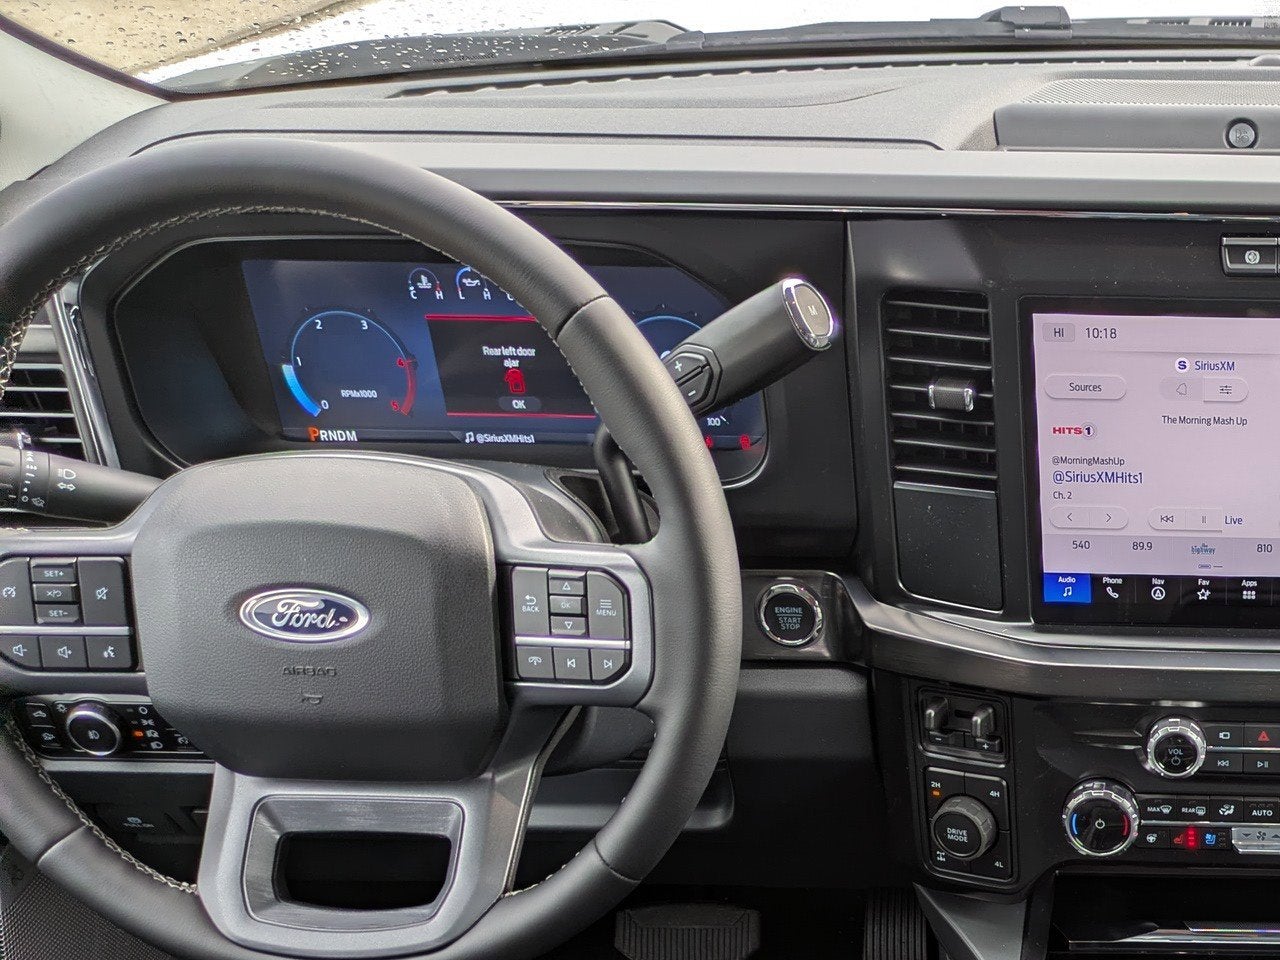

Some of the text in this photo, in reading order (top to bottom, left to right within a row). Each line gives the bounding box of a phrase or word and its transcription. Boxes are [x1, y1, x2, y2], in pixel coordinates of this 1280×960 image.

[410, 291, 417, 299] C
[435, 291, 443, 300] H
[459, 291, 465, 300] L
[483, 291, 491, 300] H
[315, 320, 323, 329] 2
[361, 320, 368, 330] 3
[1054, 328, 1064, 337] HI
[1085, 328, 1117, 339] 10:18
[482, 346, 535, 357] Rear left door
[296, 357, 302, 366] 1
[1195, 360, 1235, 371] SiriusXM
[1069, 383, 1102, 392] Sources
[321, 400, 329, 410] 0
[512, 400, 526, 409] OK
[707, 417, 721, 427] 100
[1162, 415, 1247, 427] The Morning Mash Up
[1053, 427, 1082, 435] HITS
[476, 434, 535, 444] @SiriusXMHits1
[1052, 456, 1125, 466] @MorningMashUp
[1053, 470, 1143, 484] @SiriusXMHits1
[1053, 491, 1072, 499] Ch. 2
[1224, 516, 1243, 525] Live
[1072, 540, 1091, 550] 540
[1132, 541, 1152, 551] 89.9
[1257, 544, 1273, 553] 810
[1102, 577, 1122, 585] Phone
[1241, 580, 1257, 589] Apps
[271, 599, 336, 628] Ford
[282, 666, 338, 676] AIRBAG
[948, 834, 968, 842] MODE
